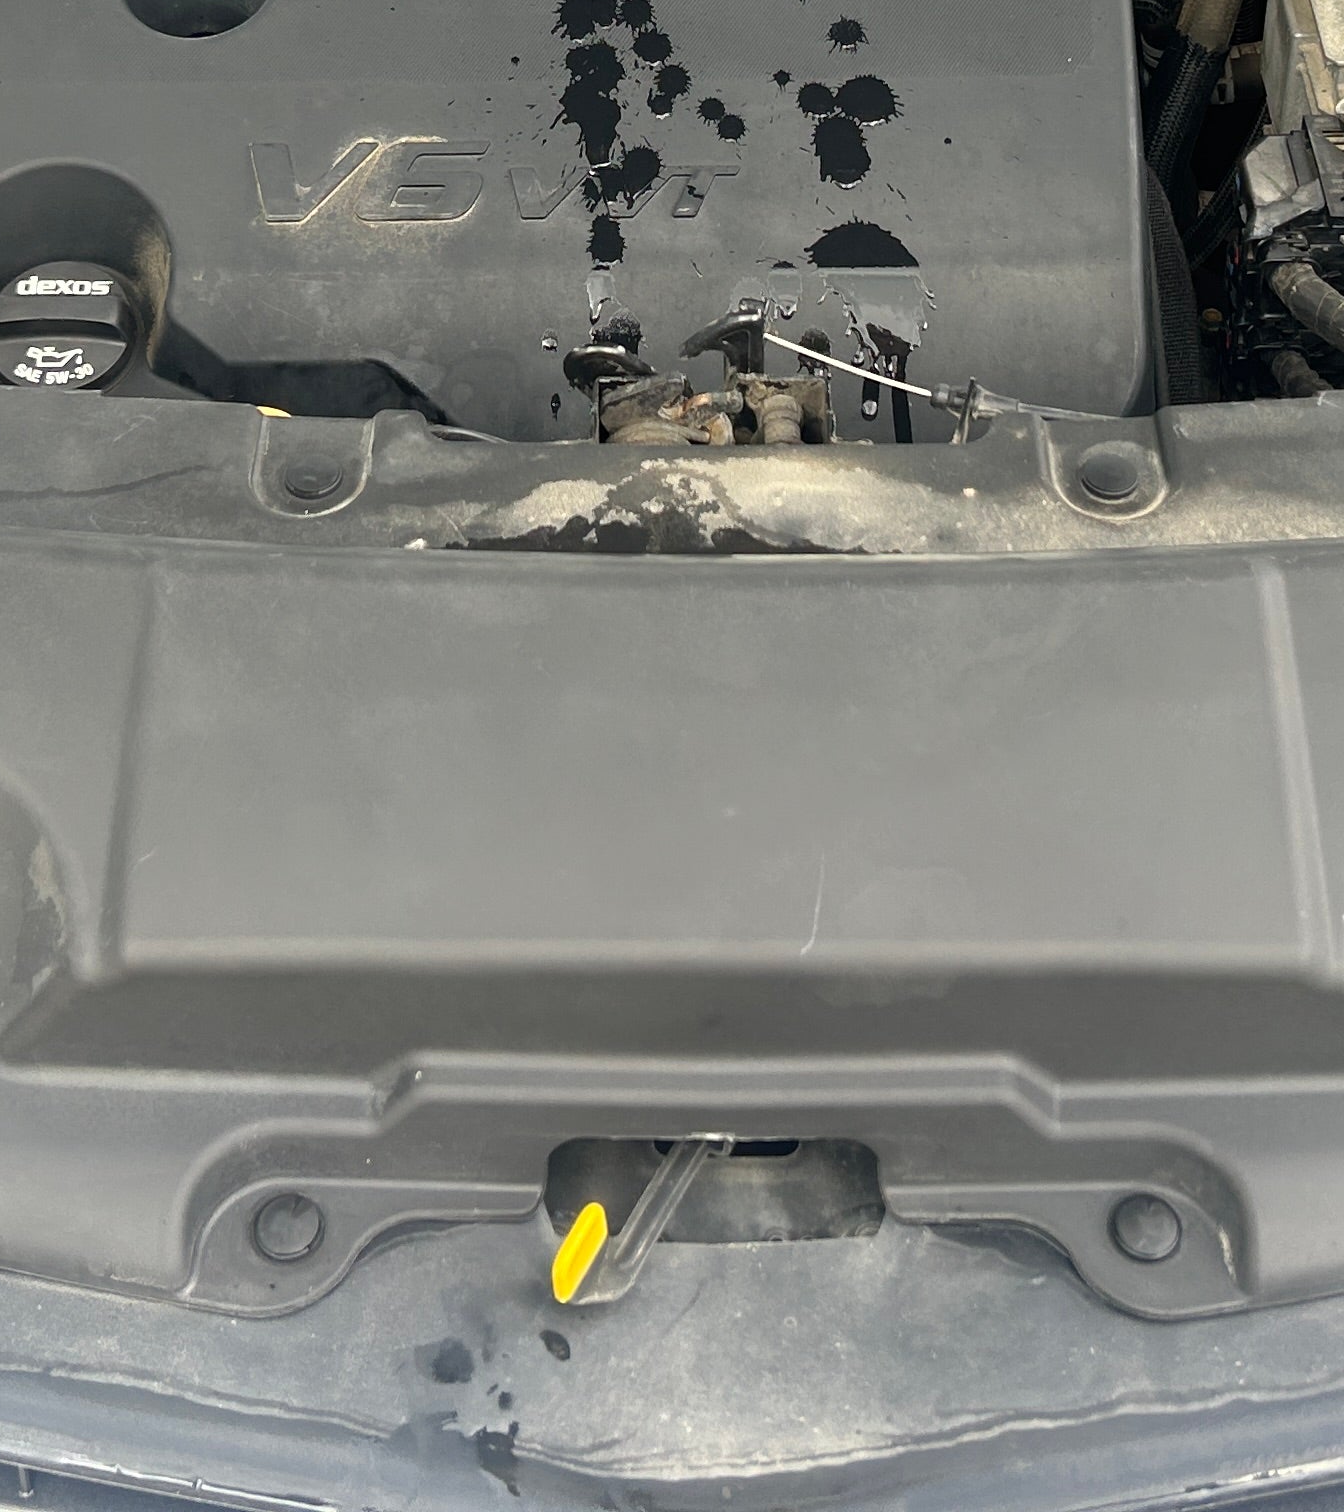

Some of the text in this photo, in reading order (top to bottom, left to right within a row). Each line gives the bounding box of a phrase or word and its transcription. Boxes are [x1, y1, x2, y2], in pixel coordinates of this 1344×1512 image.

[250, 136, 492, 224] V6
[16, 275, 114, 296] dexos
[13, 363, 94, 385] SAE 5W-30
